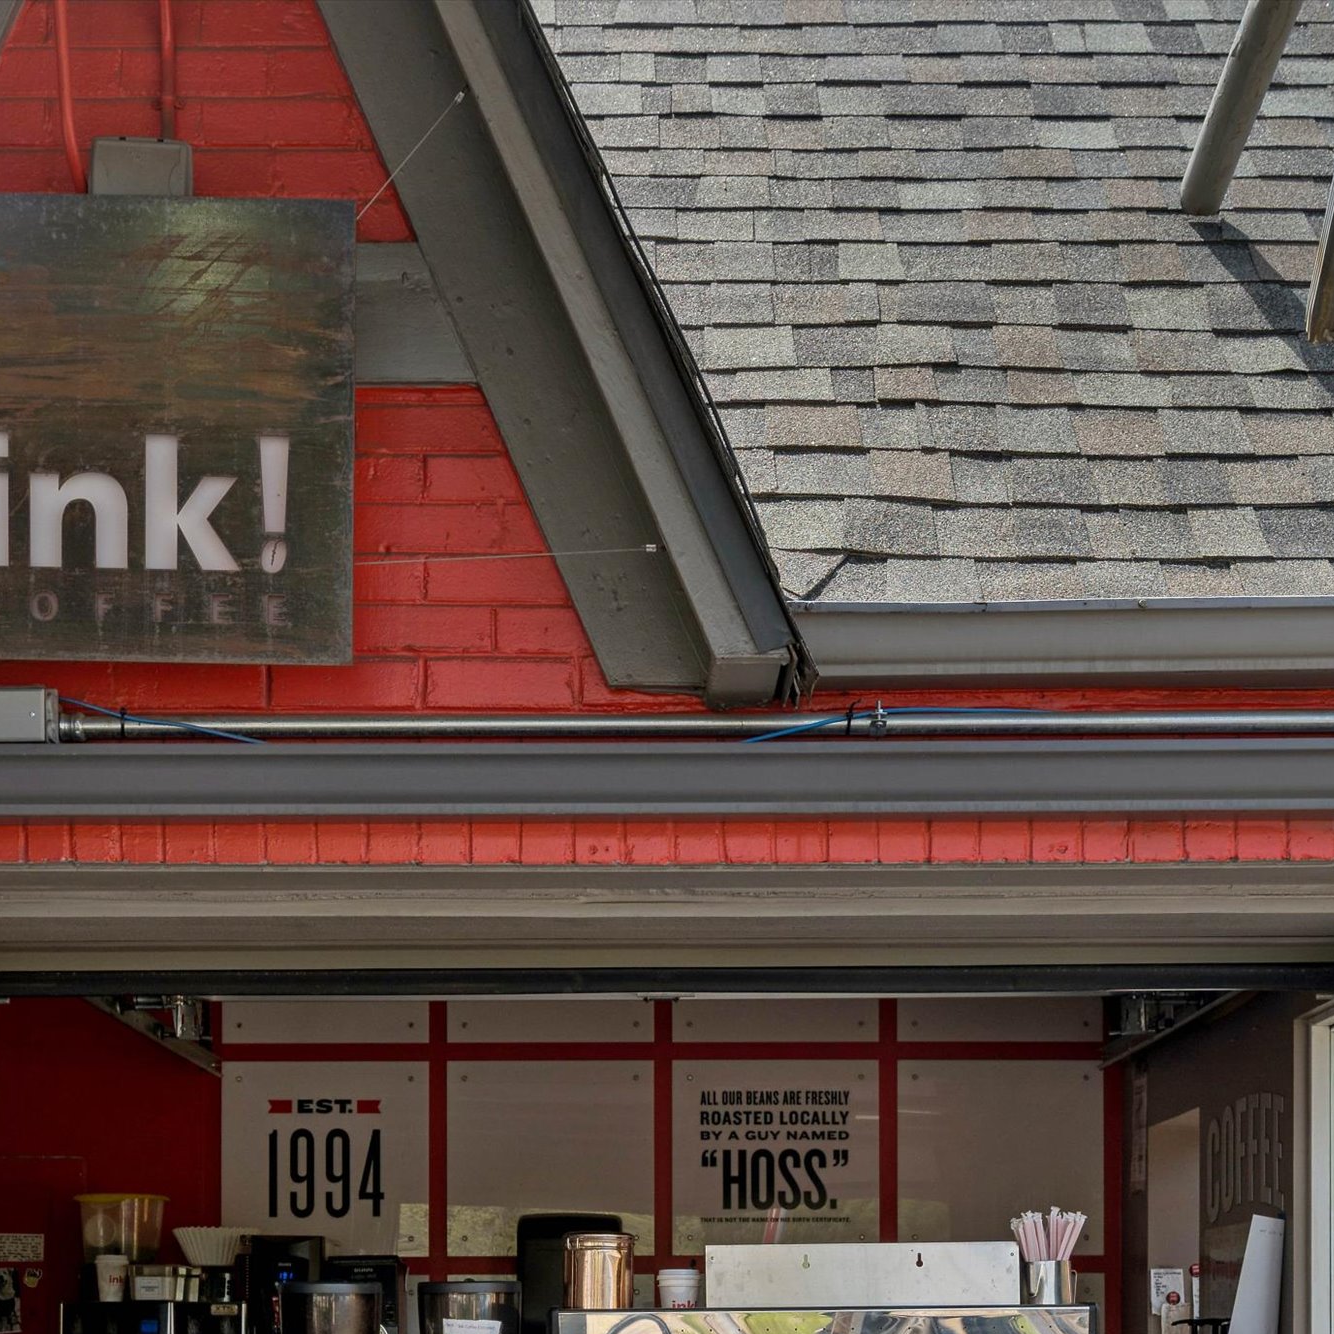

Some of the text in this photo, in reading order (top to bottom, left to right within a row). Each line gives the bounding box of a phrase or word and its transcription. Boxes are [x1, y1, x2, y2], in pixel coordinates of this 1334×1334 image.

[700, 1091, 849, 1106] ALL OUR BEANS ARE FRESHLY
[297, 1099, 353, 1114] EST.
[700, 1111, 849, 1125] ROASTED LOCALLY
[700, 1131, 849, 1141] BY A GUY NAMED
[269, 1128, 384, 1218] 1994
